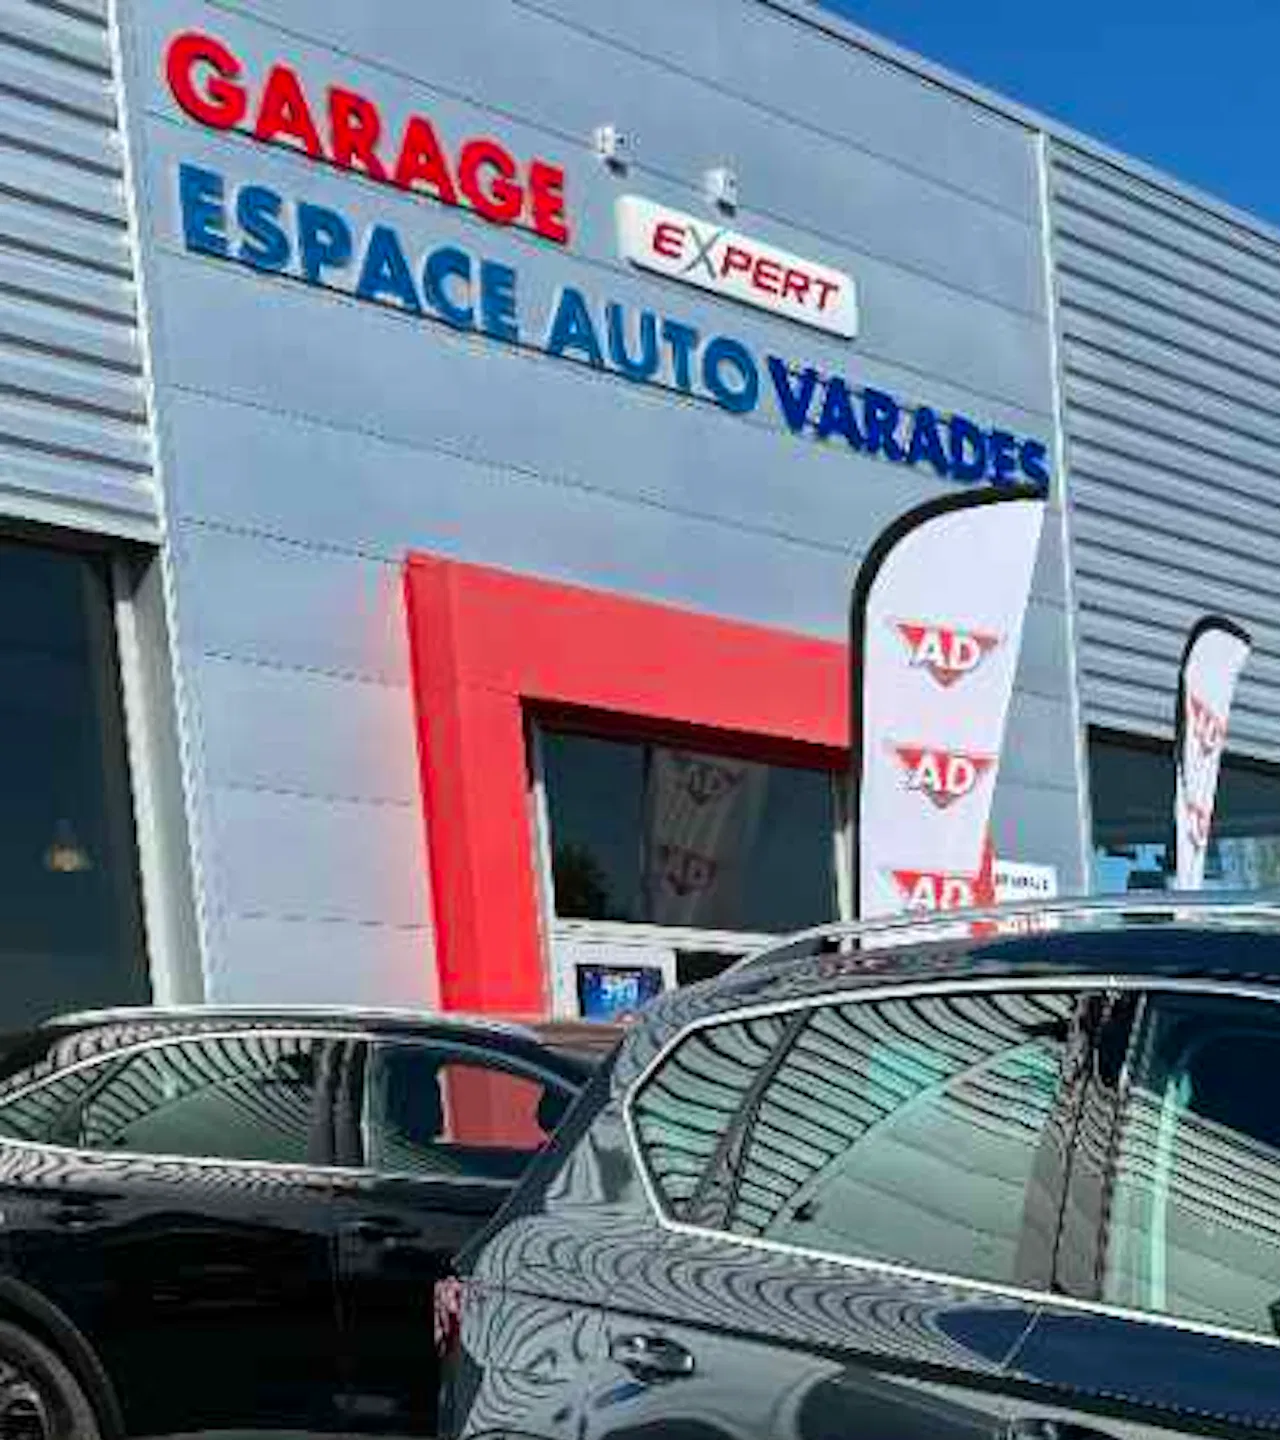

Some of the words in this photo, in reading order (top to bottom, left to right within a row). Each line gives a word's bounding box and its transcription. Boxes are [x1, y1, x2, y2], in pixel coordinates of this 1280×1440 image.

[166, 32, 568, 245] GARAGE
[178, 161, 518, 342] ESPACE
[547, 286, 759, 413] AUTO
[767, 356, 1050, 490] VARADES
[913, 629, 981, 671] AD
[916, 753, 976, 794] AD
